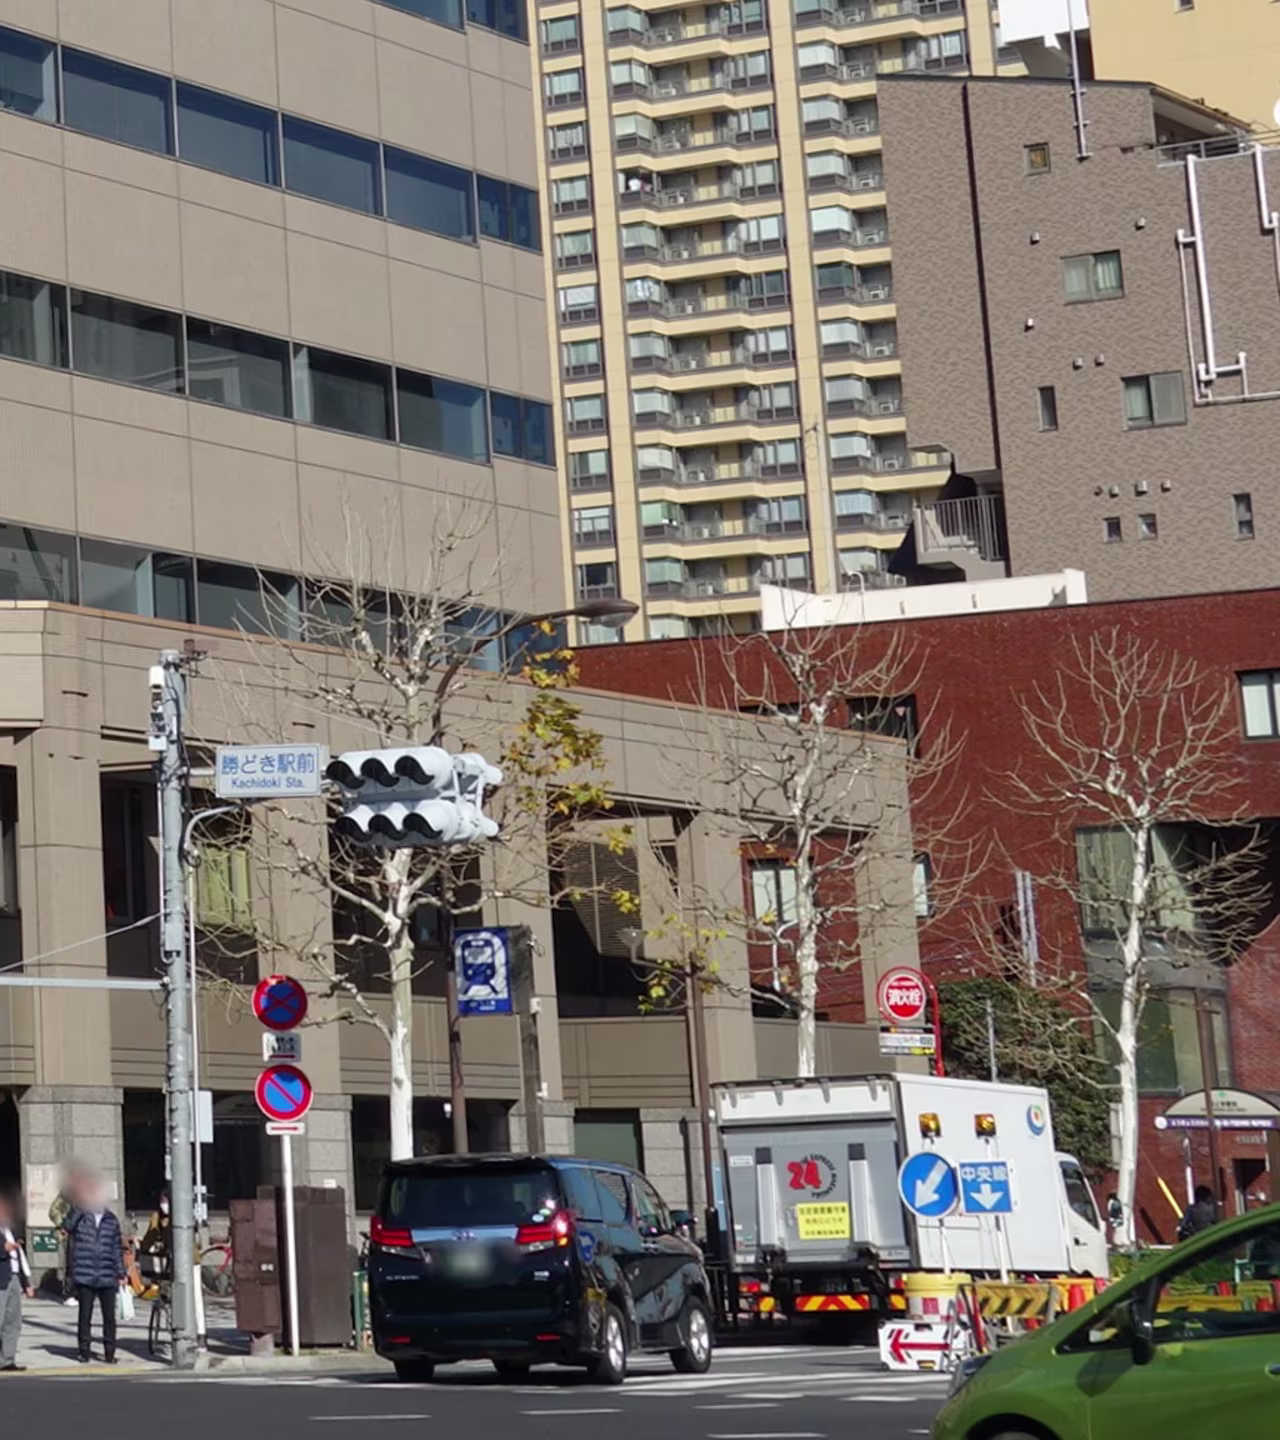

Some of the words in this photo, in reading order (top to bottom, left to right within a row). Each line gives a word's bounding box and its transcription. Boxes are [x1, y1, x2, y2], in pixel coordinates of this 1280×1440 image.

[221, 752, 316, 775] 勝どき駅前
[231, 777, 281, 789] Kachidoki
[285, 777, 305, 788] Sta.
[888, 987, 922, 1007] 消火栓
[786, 1161, 823, 1191] 24
